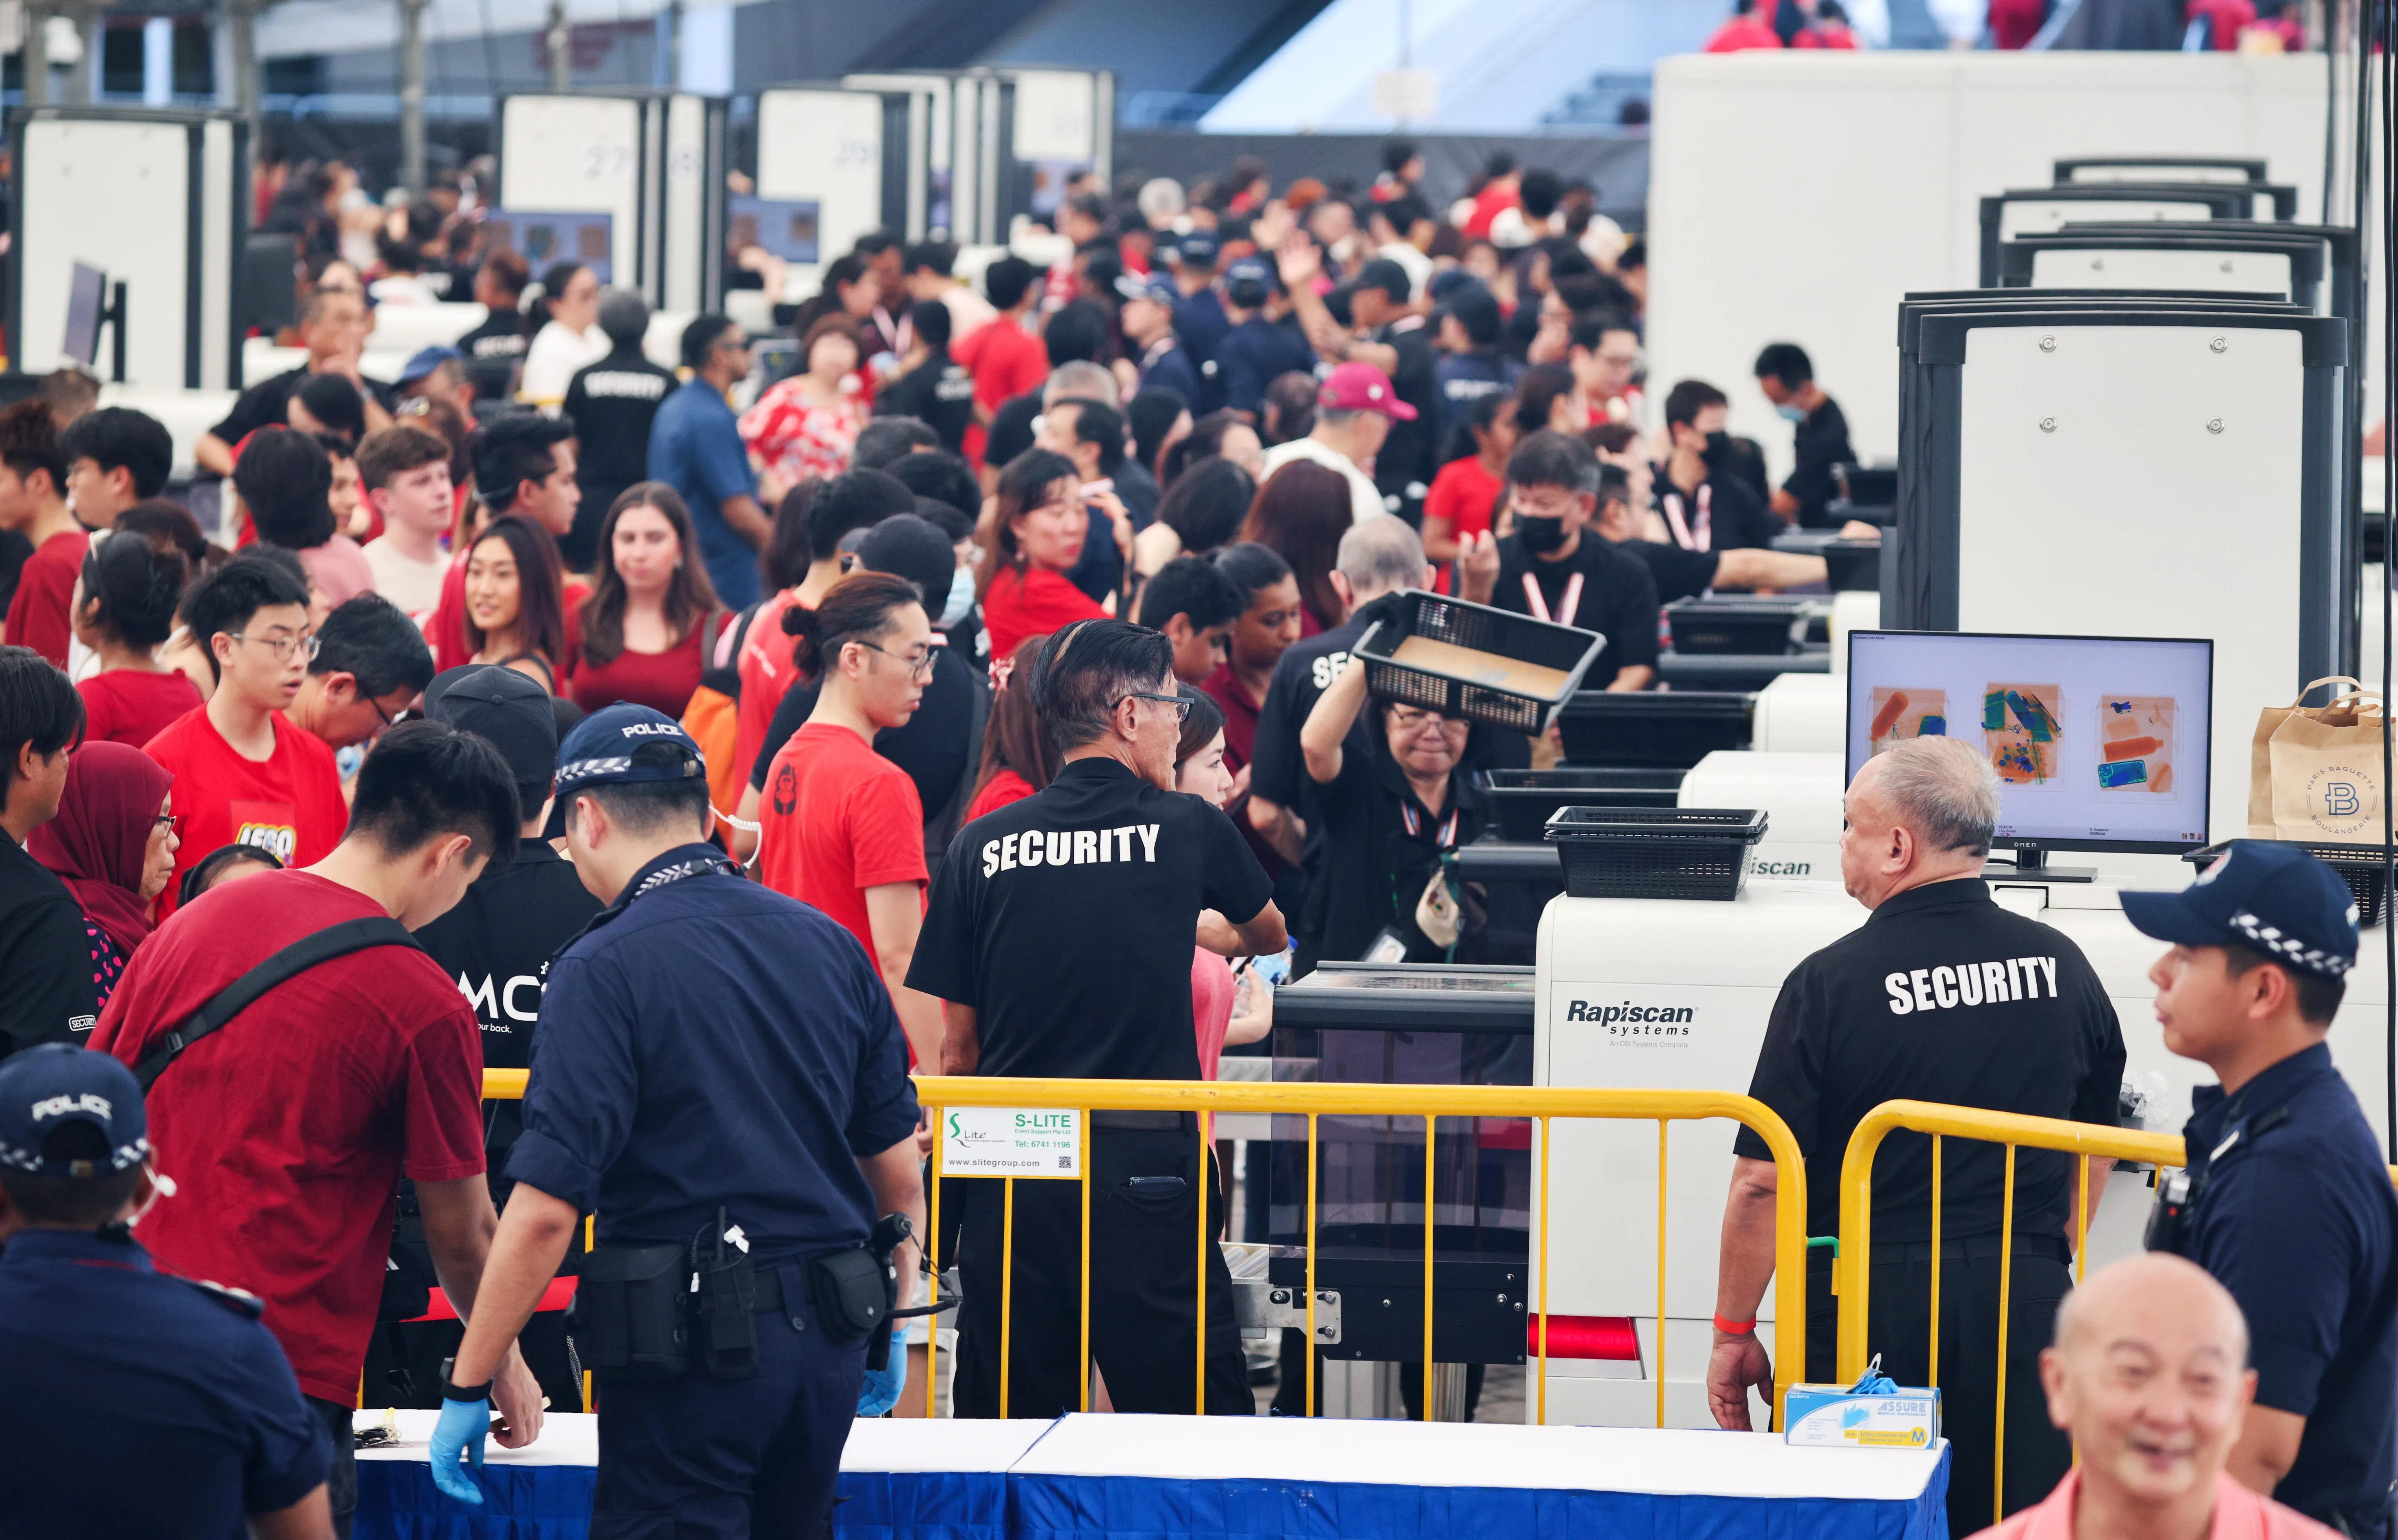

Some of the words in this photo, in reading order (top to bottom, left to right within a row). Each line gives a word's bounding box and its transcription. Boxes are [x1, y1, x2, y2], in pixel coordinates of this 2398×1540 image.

[1312, 651, 1355, 689] SE
[621, 723, 683, 738] POLICE
[2307, 769, 2325, 790] PARIS
[2329, 766, 2376, 791] BAGUETTE
[2325, 783, 2359, 815] B
[2311, 815, 2371, 834] BOULANGERIE
[982, 824, 1160, 878] SECURITY
[1751, 857, 1811, 875] iscan
[1885, 957, 2057, 1015] SECURITY
[1567, 1000, 1693, 1027] Rapiscan
[490, 1023, 512, 1033] back.
[1610, 1025, 1689, 1036] systems
[31, 1093, 113, 1121] POLICE
[1015, 1114, 1071, 1128] S-LITE
[965, 1130, 986, 1139] Lite
[949, 1159, 1039, 1168] www.slitegroup.com
[1877, 1401, 1926, 1412] ASSURE
[1911, 1431, 1925, 1443] M
